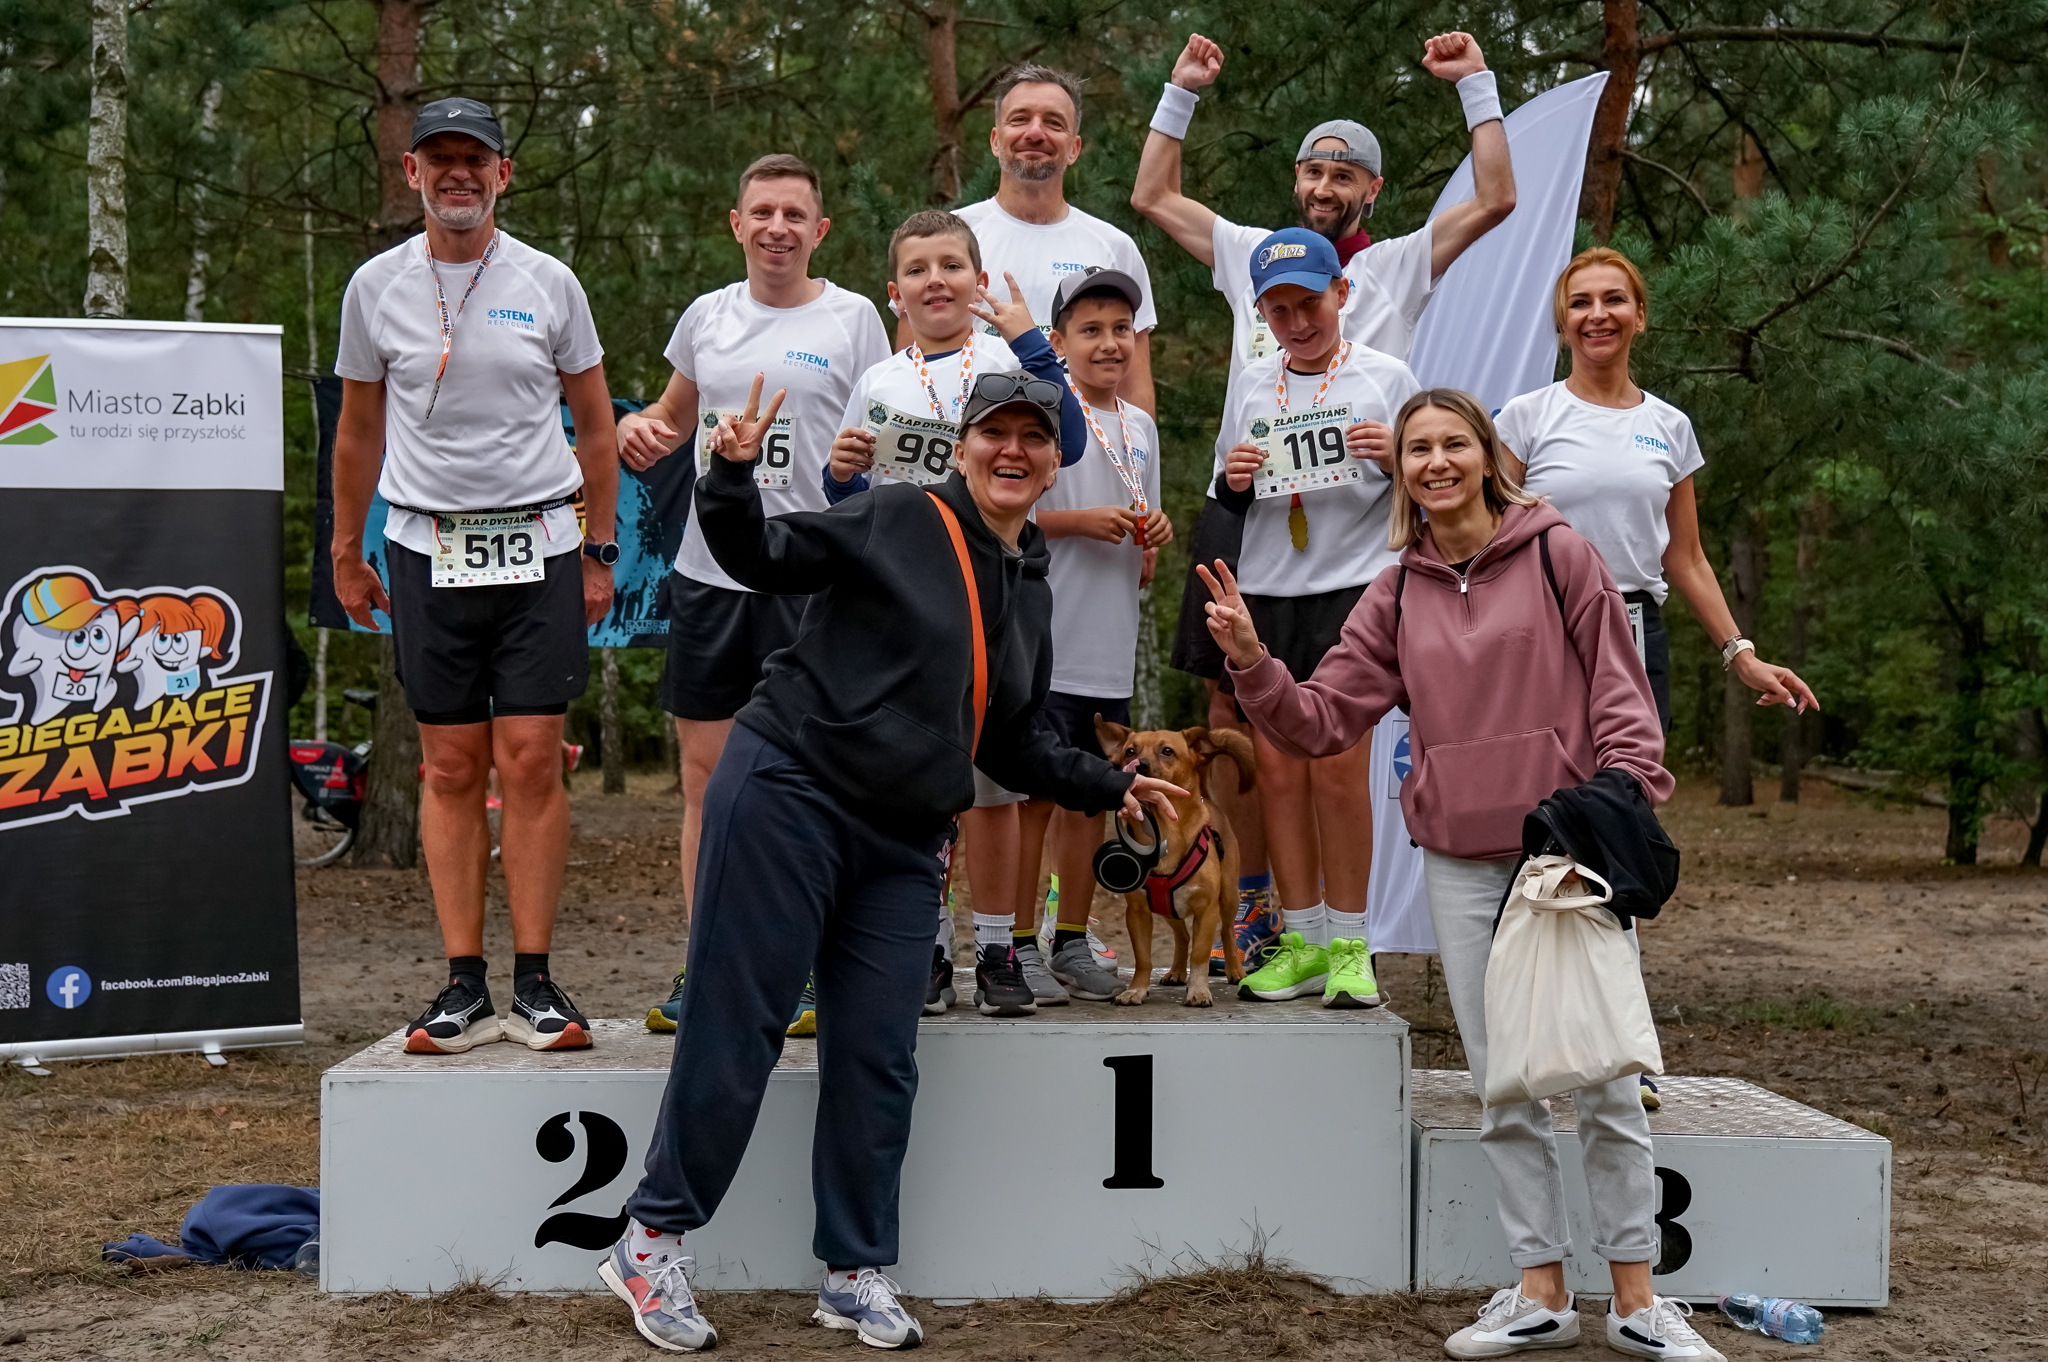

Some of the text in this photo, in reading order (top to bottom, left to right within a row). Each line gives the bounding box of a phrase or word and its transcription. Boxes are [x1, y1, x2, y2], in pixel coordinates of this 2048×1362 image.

[487, 319, 535, 331] RECYCLING
[498, 309, 534, 324] STENA
[783, 359, 828, 375] RECYCLING
[795, 351, 829, 368] STENA
[68, 389, 246, 420] Miasto Ząbki
[926, 384, 940, 405] JUNIOR
[891, 413, 921, 427] ZŁAP
[1273, 415, 1301, 427] ZŁAP
[1301, 407, 1348, 422] DYSTANS
[70, 423, 246, 443] tu rodzi się przyszłość
[894, 432, 953, 476] 98
[1283, 426, 1346, 470] 119
[460, 516, 533, 526] ZŁAP DYSTANS
[464, 532, 534, 569] 513
[65, 683, 87, 696] 20
[175, 677, 190, 689] 21
[101, 971, 270, 991] facebook.com/BiegajaceZabki
[1102, 1053, 1165, 1190] 1
[535, 1111, 630, 1251] 2
